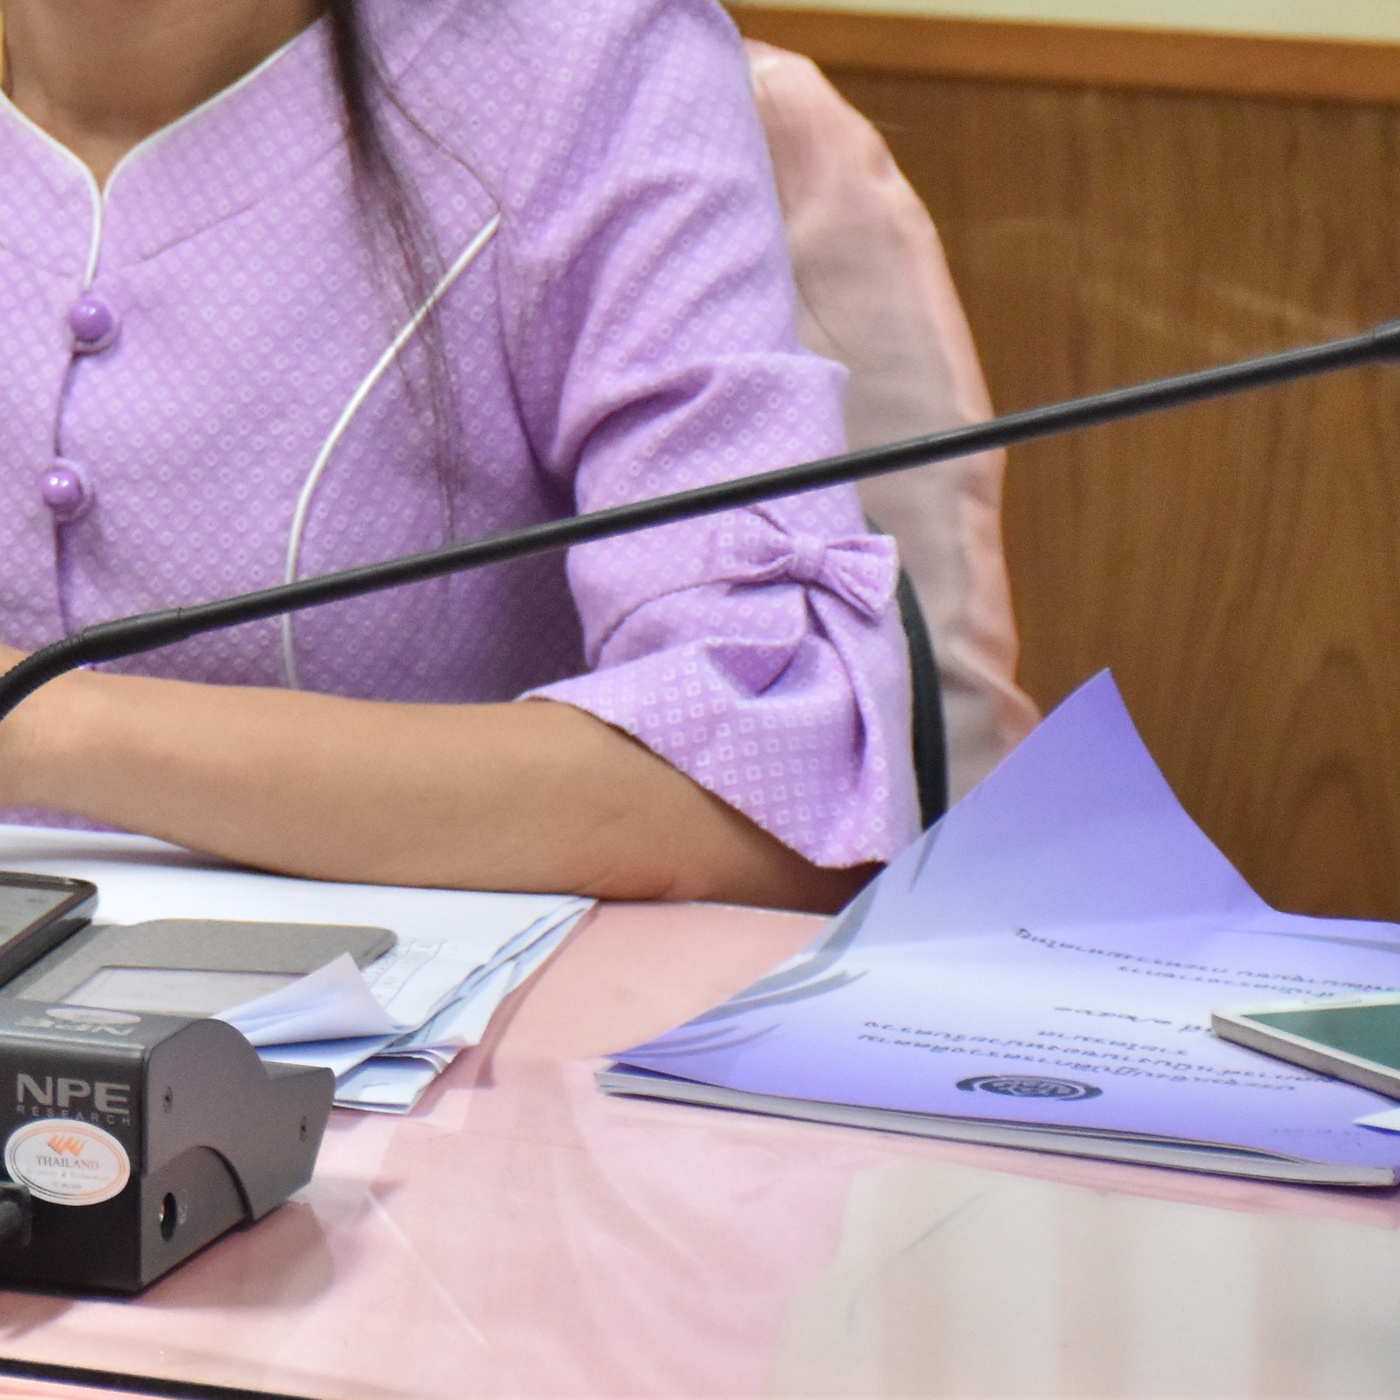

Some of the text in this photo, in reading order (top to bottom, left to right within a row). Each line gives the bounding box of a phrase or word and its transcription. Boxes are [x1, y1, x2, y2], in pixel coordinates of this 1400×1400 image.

[16, 1073, 131, 1115] NPE
[15, 1104, 131, 1126] RESEARCH
[35, 1155, 99, 1170] THAILAND
